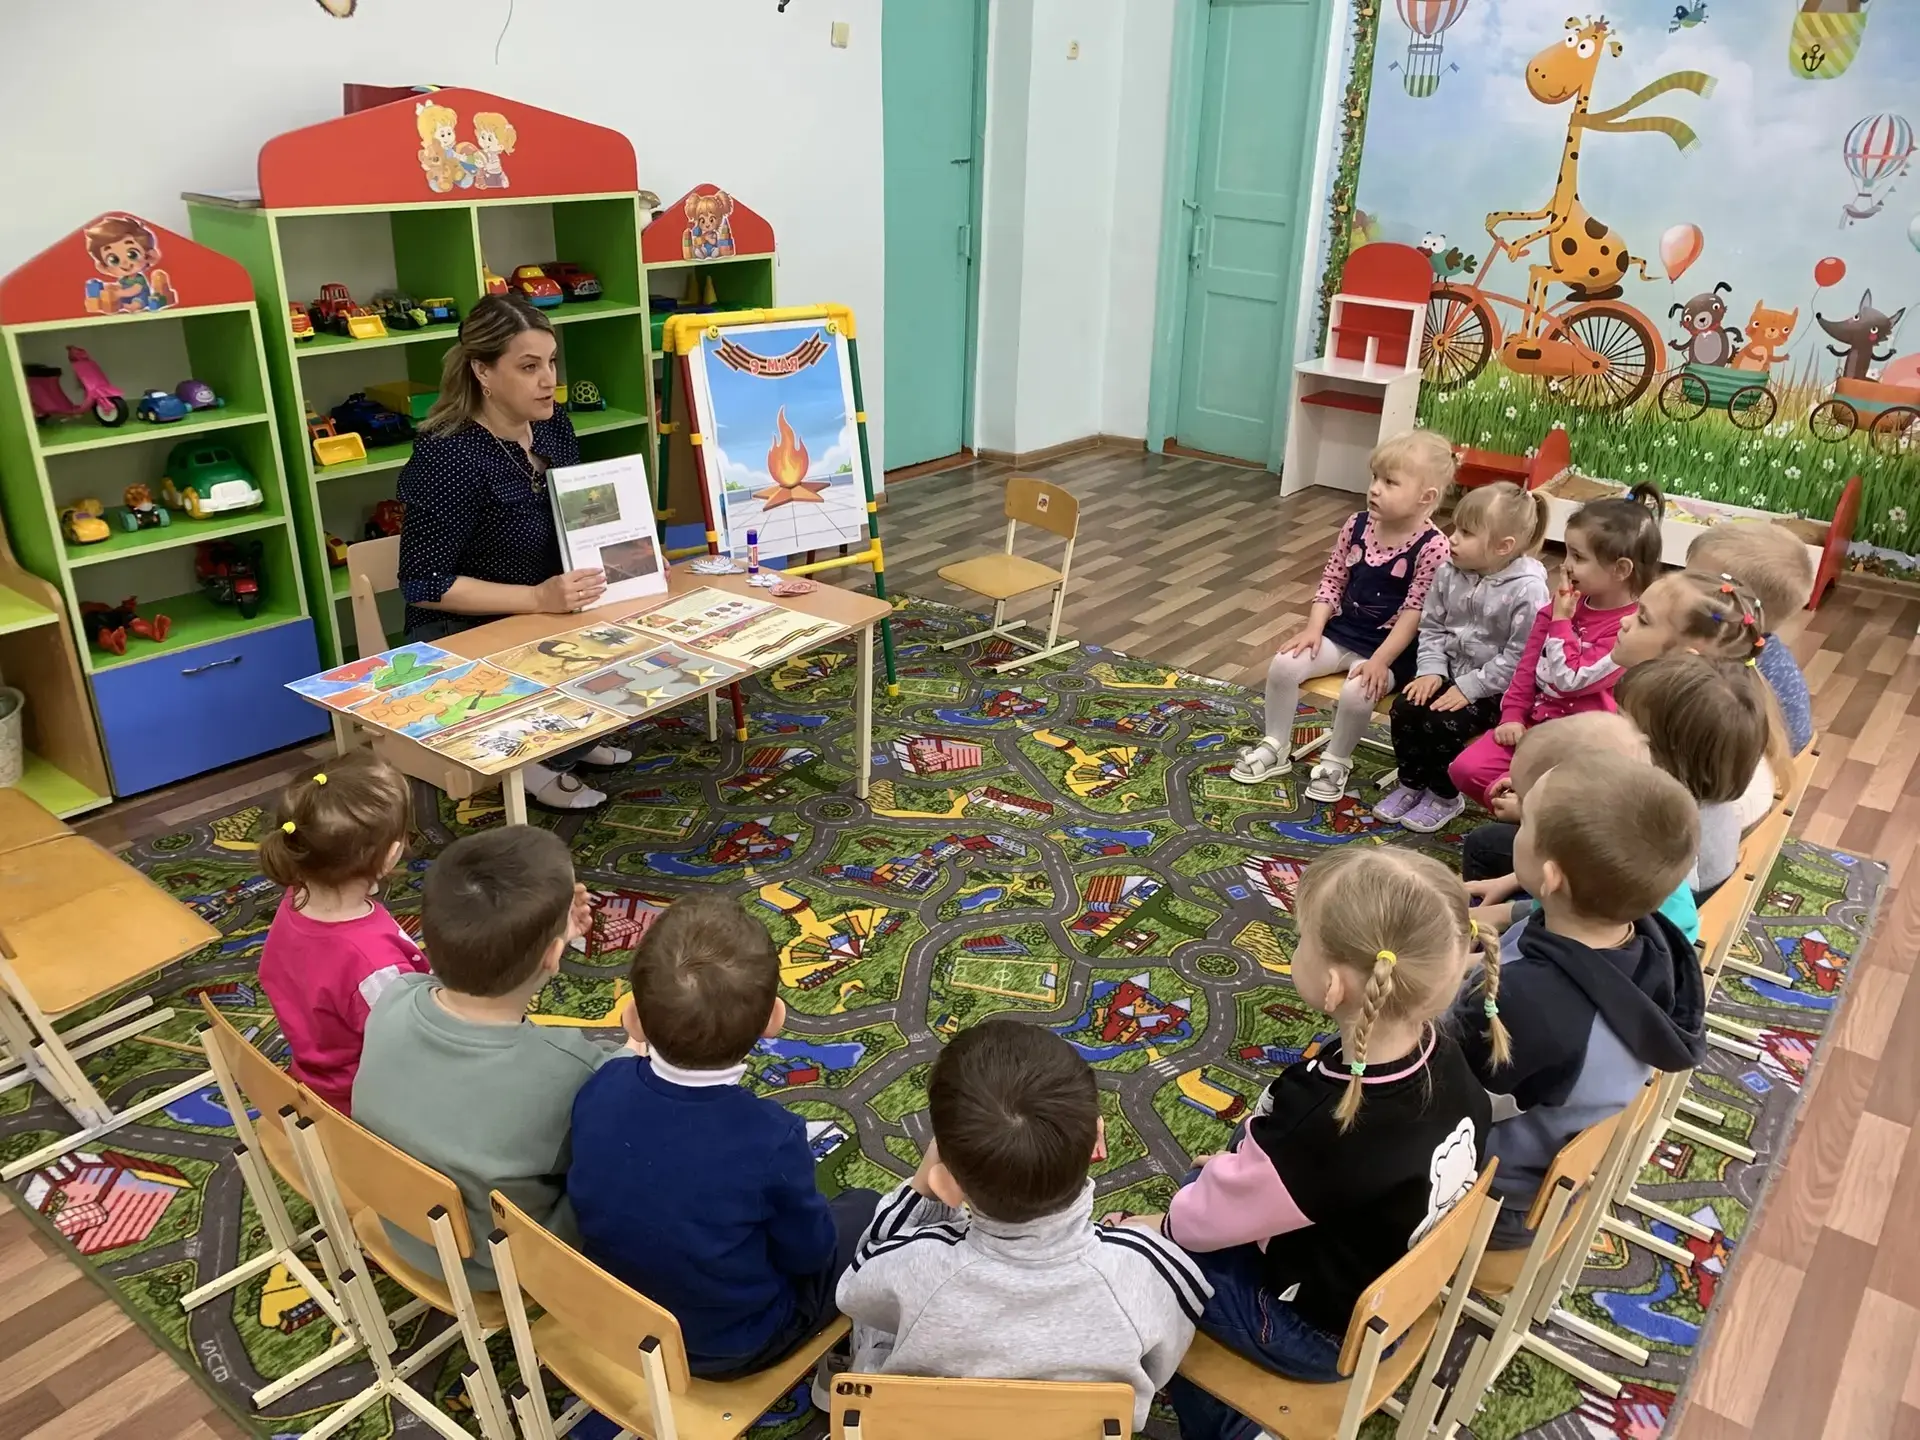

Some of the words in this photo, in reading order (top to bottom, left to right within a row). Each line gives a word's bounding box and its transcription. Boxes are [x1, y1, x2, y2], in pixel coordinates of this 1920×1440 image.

[750, 359, 760, 375] 9
[766, 356, 799, 372] МАЯ
[201, 1339, 229, 1383] BUS
